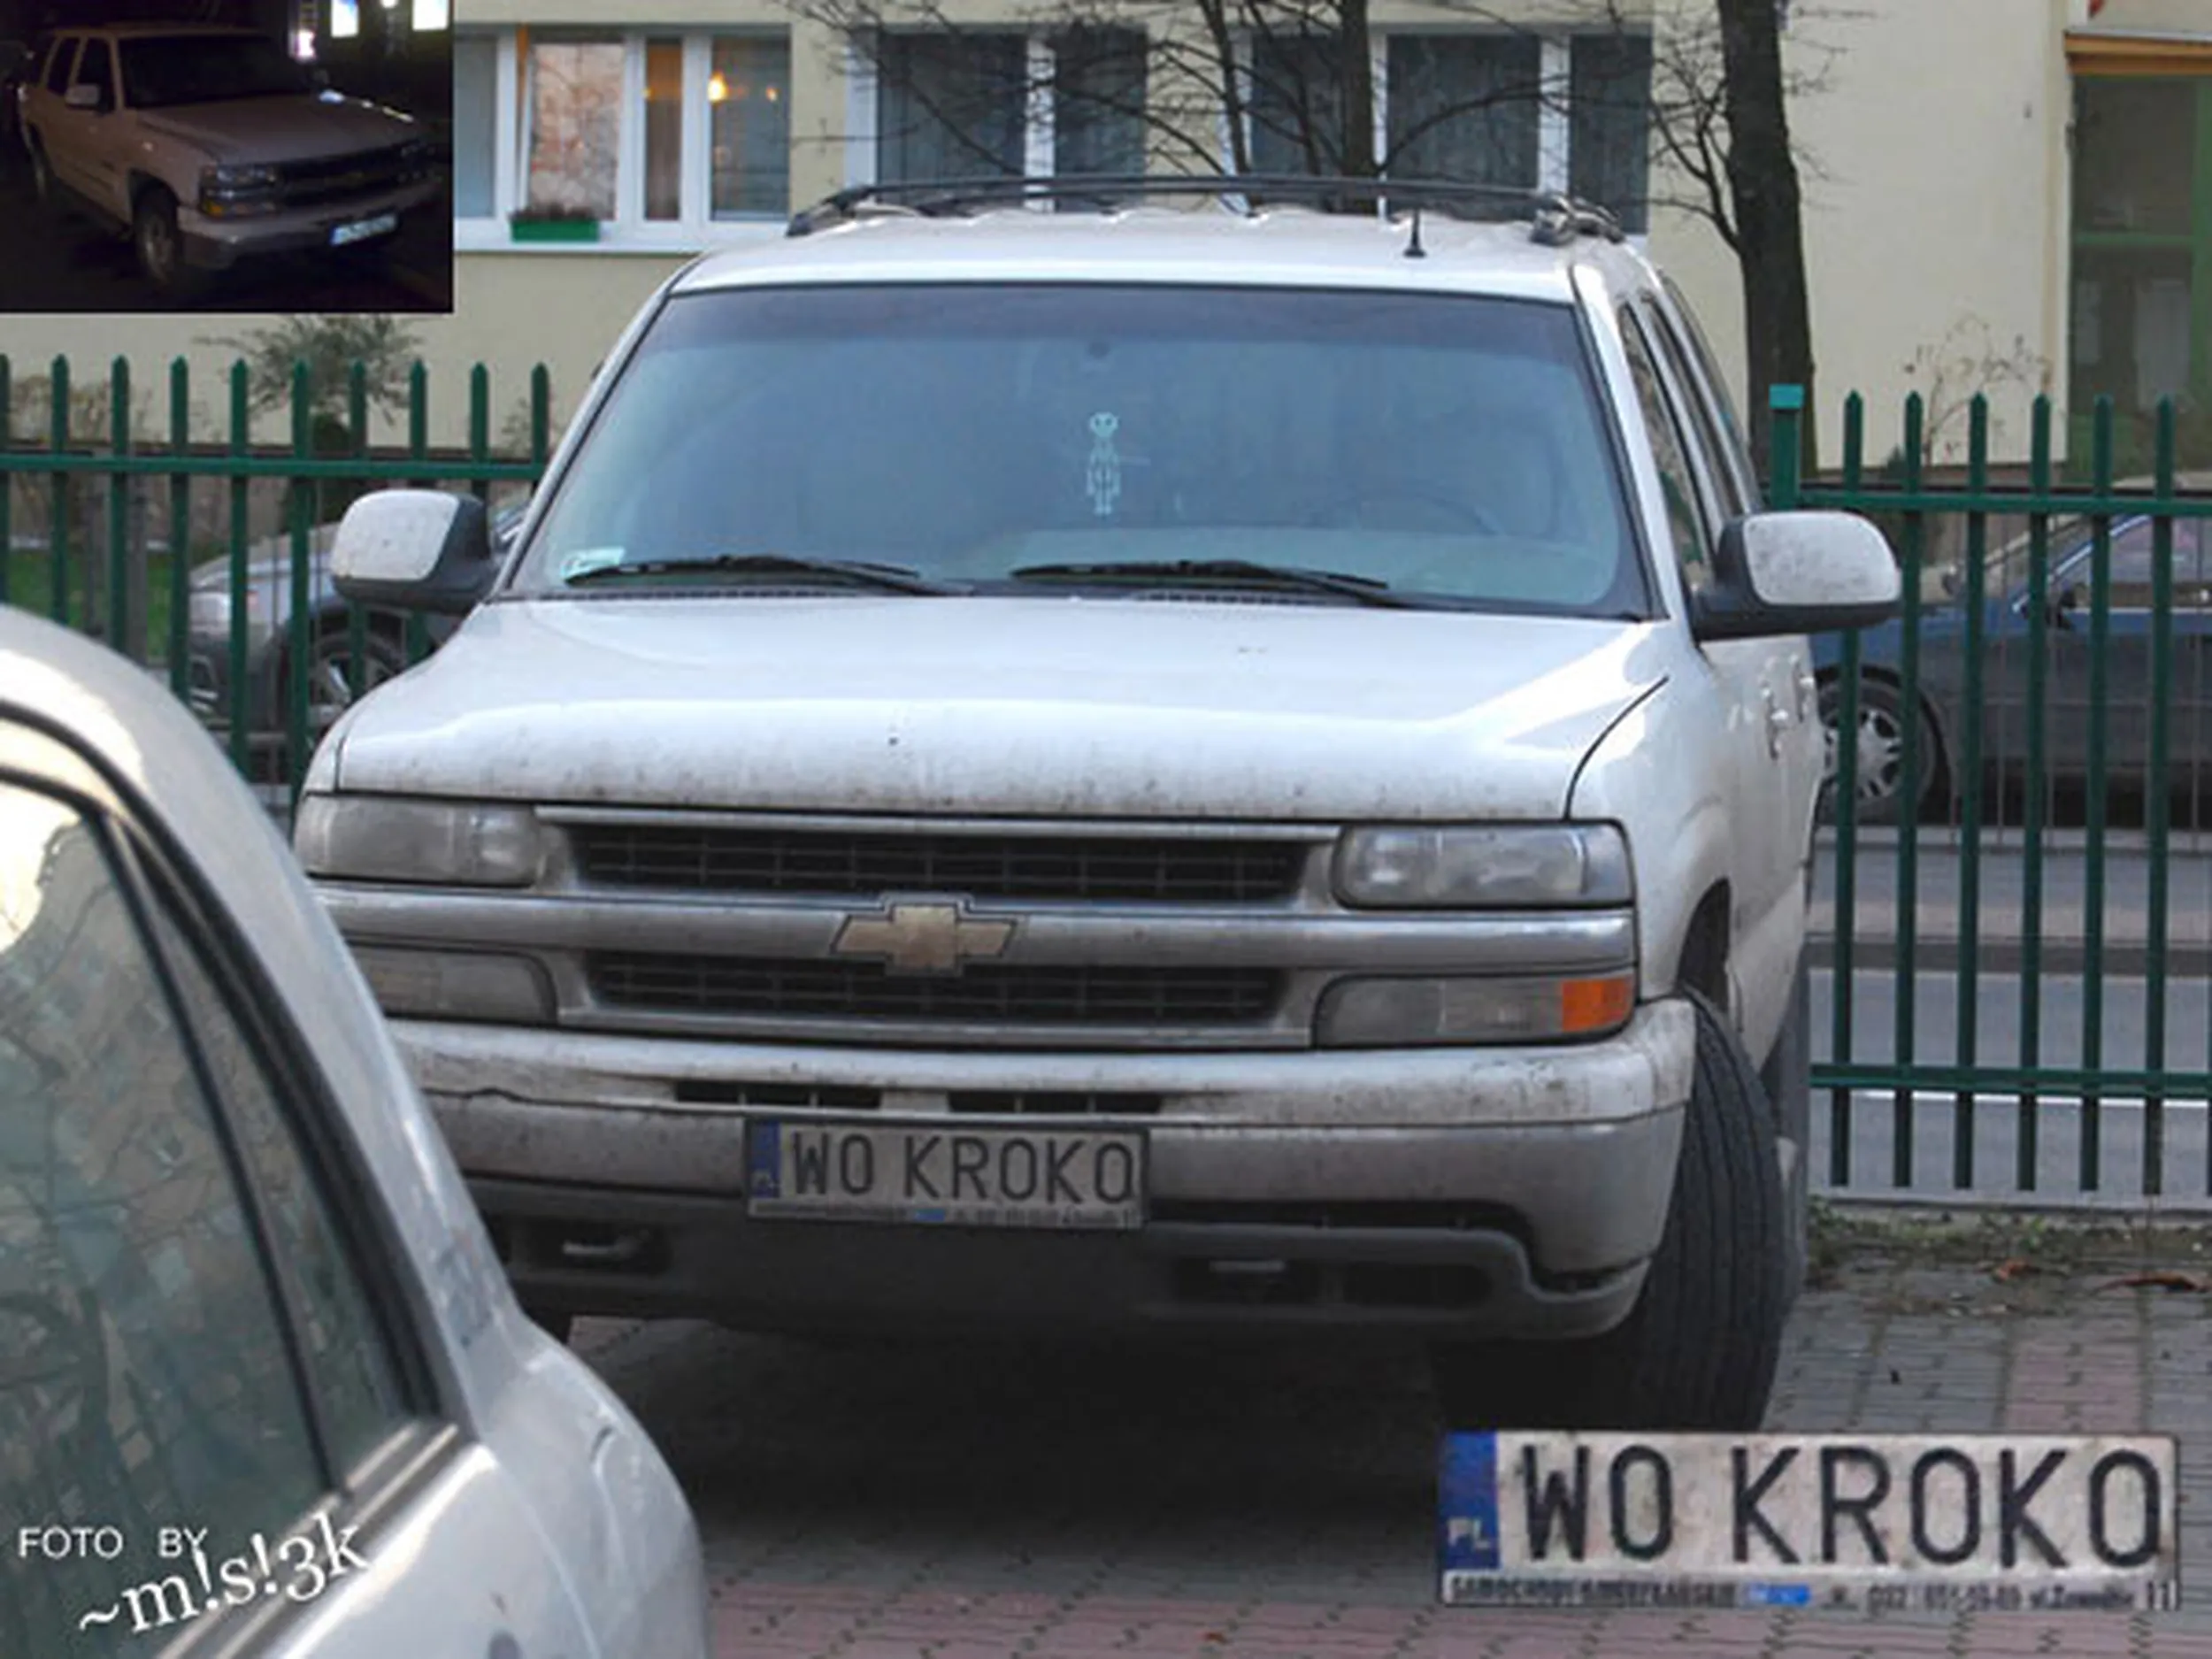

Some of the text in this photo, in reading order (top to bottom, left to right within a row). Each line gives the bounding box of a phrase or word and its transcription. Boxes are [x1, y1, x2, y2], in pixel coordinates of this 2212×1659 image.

[792, 1131, 1133, 1204] WO KROKO
[1521, 1444, 2162, 1568] WO KROKO
